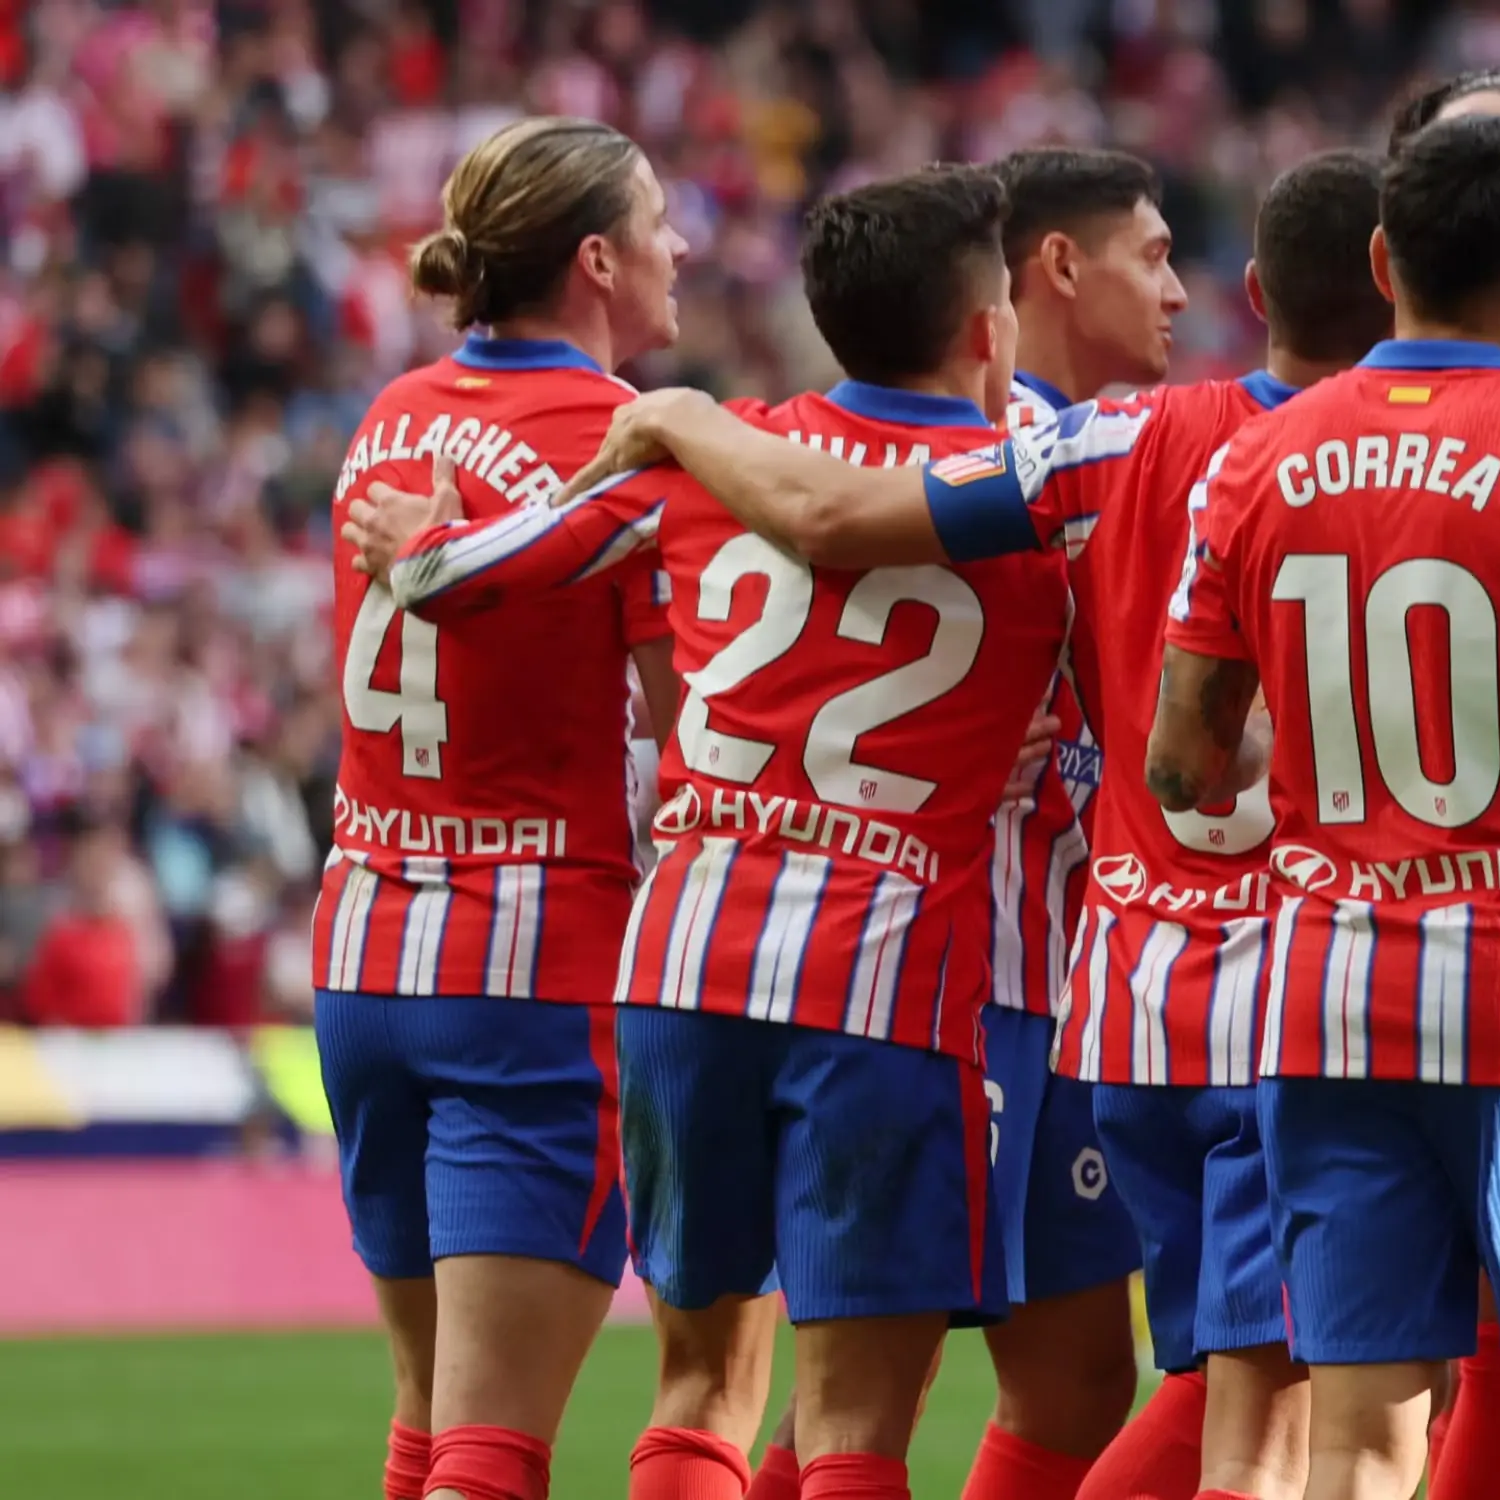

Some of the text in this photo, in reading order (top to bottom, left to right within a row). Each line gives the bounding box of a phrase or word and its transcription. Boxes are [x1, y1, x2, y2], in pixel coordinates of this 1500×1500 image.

[343, 578, 448, 780] 4
[677, 532, 984, 813] 22
[346, 798, 567, 858] HYUNDAI
[711, 788, 939, 883] HYUNDAI
